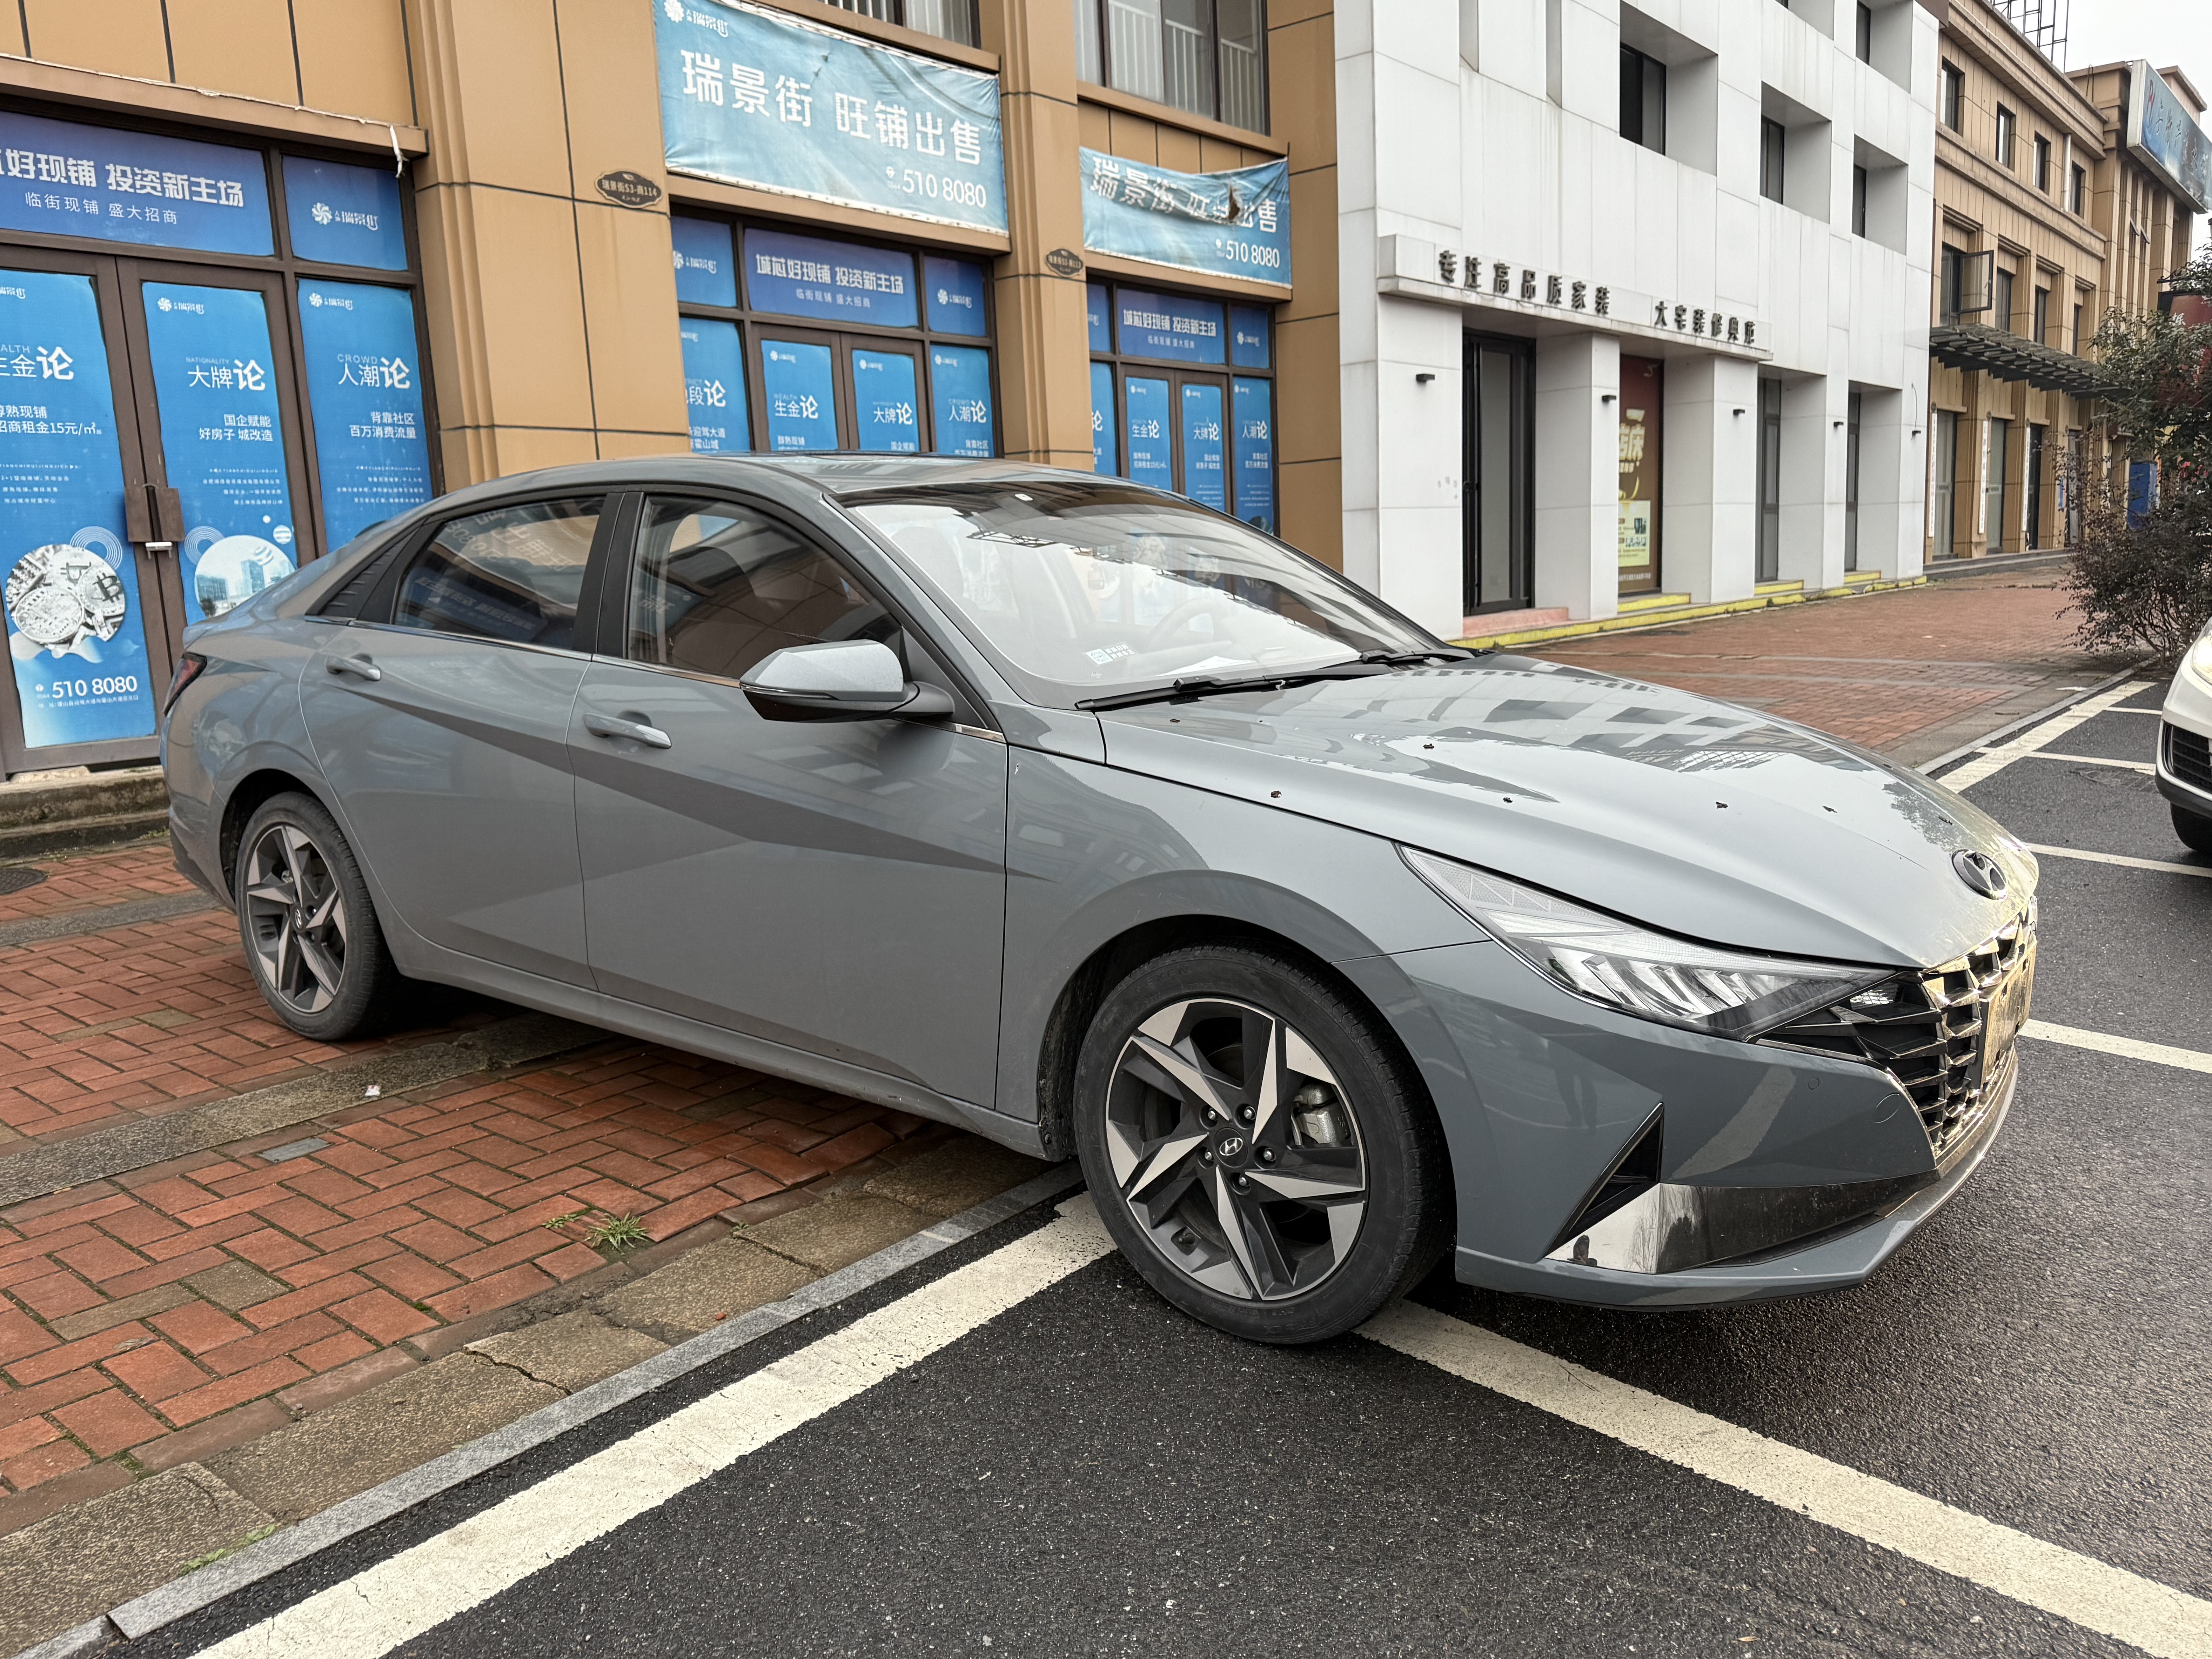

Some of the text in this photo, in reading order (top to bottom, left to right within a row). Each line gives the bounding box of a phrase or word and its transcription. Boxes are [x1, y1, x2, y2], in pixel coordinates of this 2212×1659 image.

[681, 50, 981, 165] 瑞景街 旺铺出售
[0, 148, 244, 207] 好现铺 投资新主场
[903, 169, 938, 198] 510
[943, 177, 986, 208] 8080
[25, 192, 177, 225] 临街现铺 盛大招商
[1225, 240, 1280, 269] 510 8080
[756, 254, 904, 295] 城芯好现铺 投资新主场
[185, 357, 229, 365] NATIONALITY
[337, 353, 378, 364] CROWD
[187, 359, 266, 391] 大牌论
[338, 357, 410, 389] 人潮论
[370, 411, 416, 425] 背靠社区
[775, 395, 818, 419] 生金论
[873, 402, 913, 425] 大牌论
[949, 400, 987, 423] 人潮论
[224, 414, 271, 428] 国企赋能
[349, 424, 417, 440] 百万消费流量
[1132, 419, 1160, 438] 生金论
[1193, 422, 1219, 441] 大牌论
[1242, 420, 1268, 440] 人潮论
[199, 427, 273, 441] 好房子 城改造
[52, 680, 87, 699] 510
[92, 675, 137, 695] 8080
